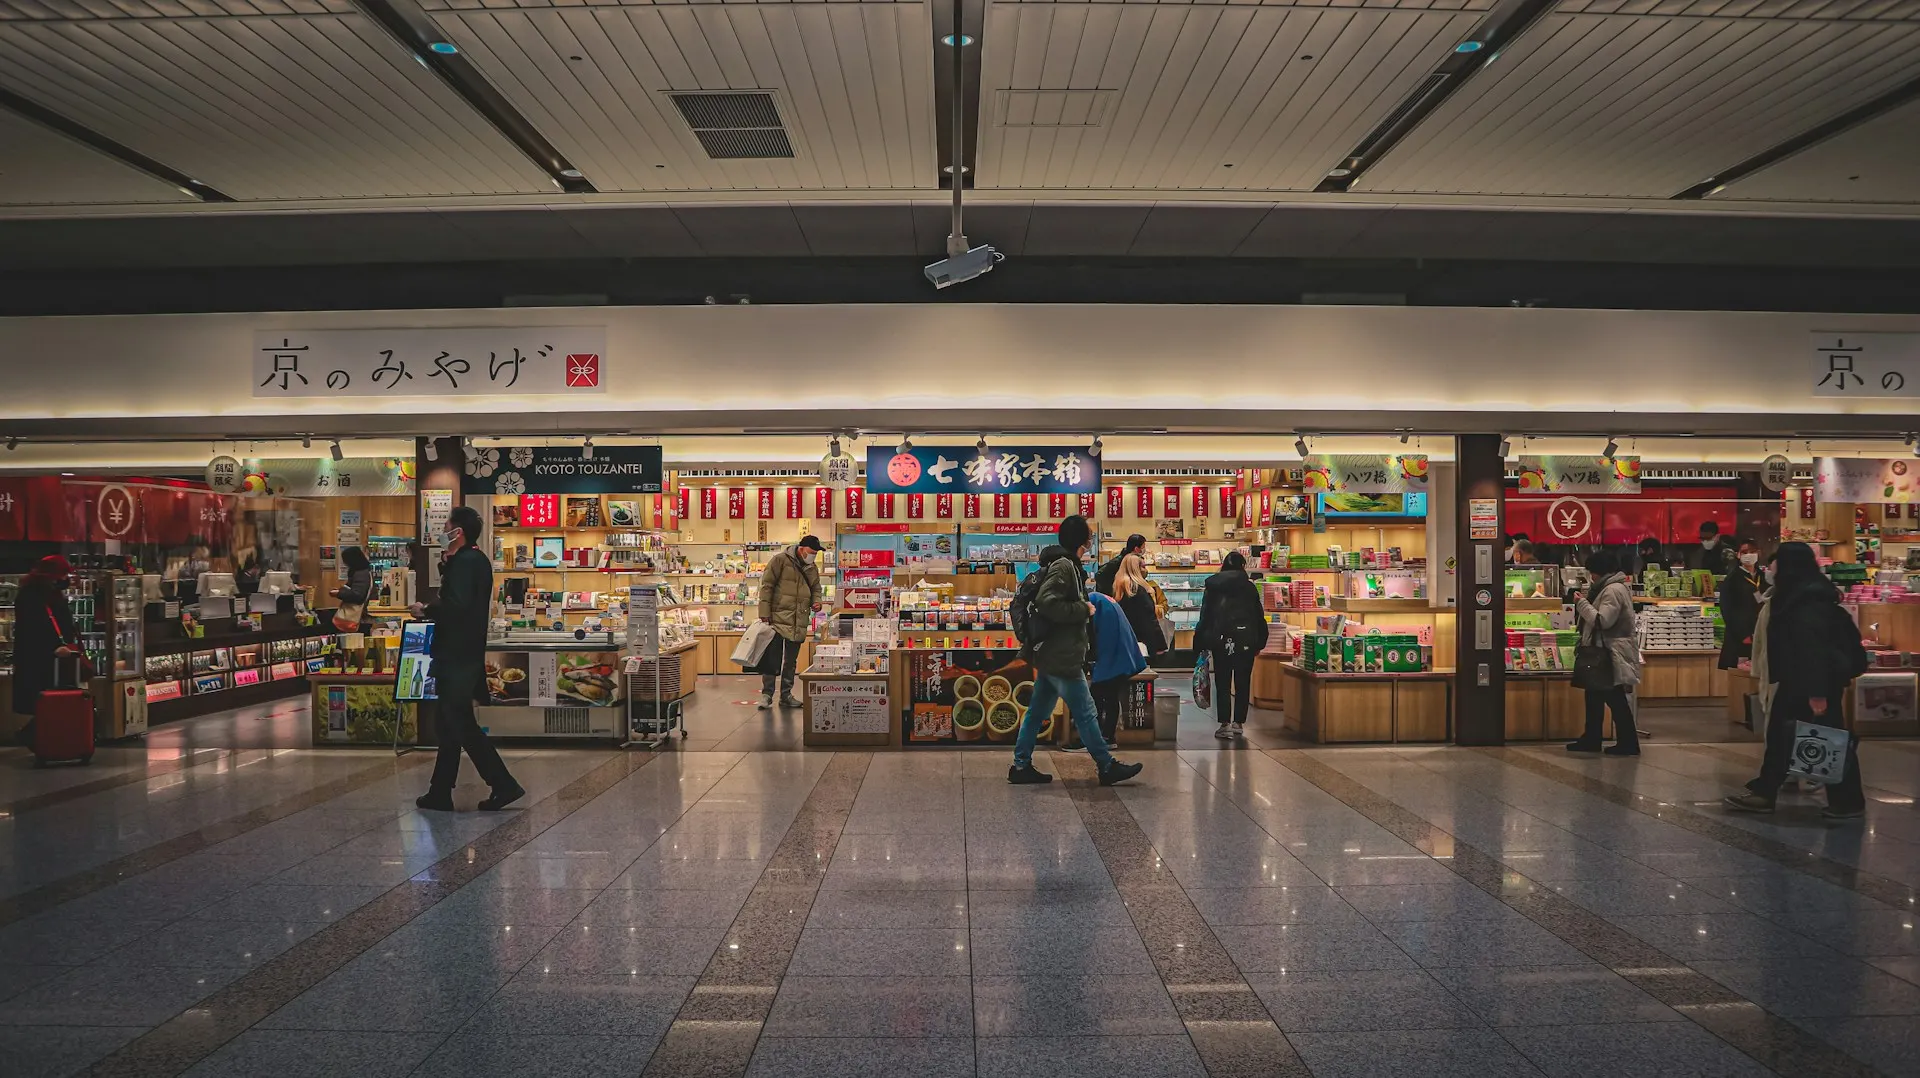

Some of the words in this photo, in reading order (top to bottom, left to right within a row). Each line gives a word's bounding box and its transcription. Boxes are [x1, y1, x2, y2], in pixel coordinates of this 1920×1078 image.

[261, 338, 554, 390] 京のみやげ
[1817, 338, 1904, 391] 京の
[214, 464, 233, 472] 期間
[828, 459, 848, 468] 期間
[1769, 462, 1786, 471] 期間
[535, 464, 574, 475] KYOTO
[577, 463, 643, 475] TOUZANTEI
[214, 476, 233, 486] 限定
[317, 473, 351, 487] お酒
[828, 471, 848, 481] 限定
[1769, 475, 1785, 484] 限定
[822, 685, 841, 693] Calbee
